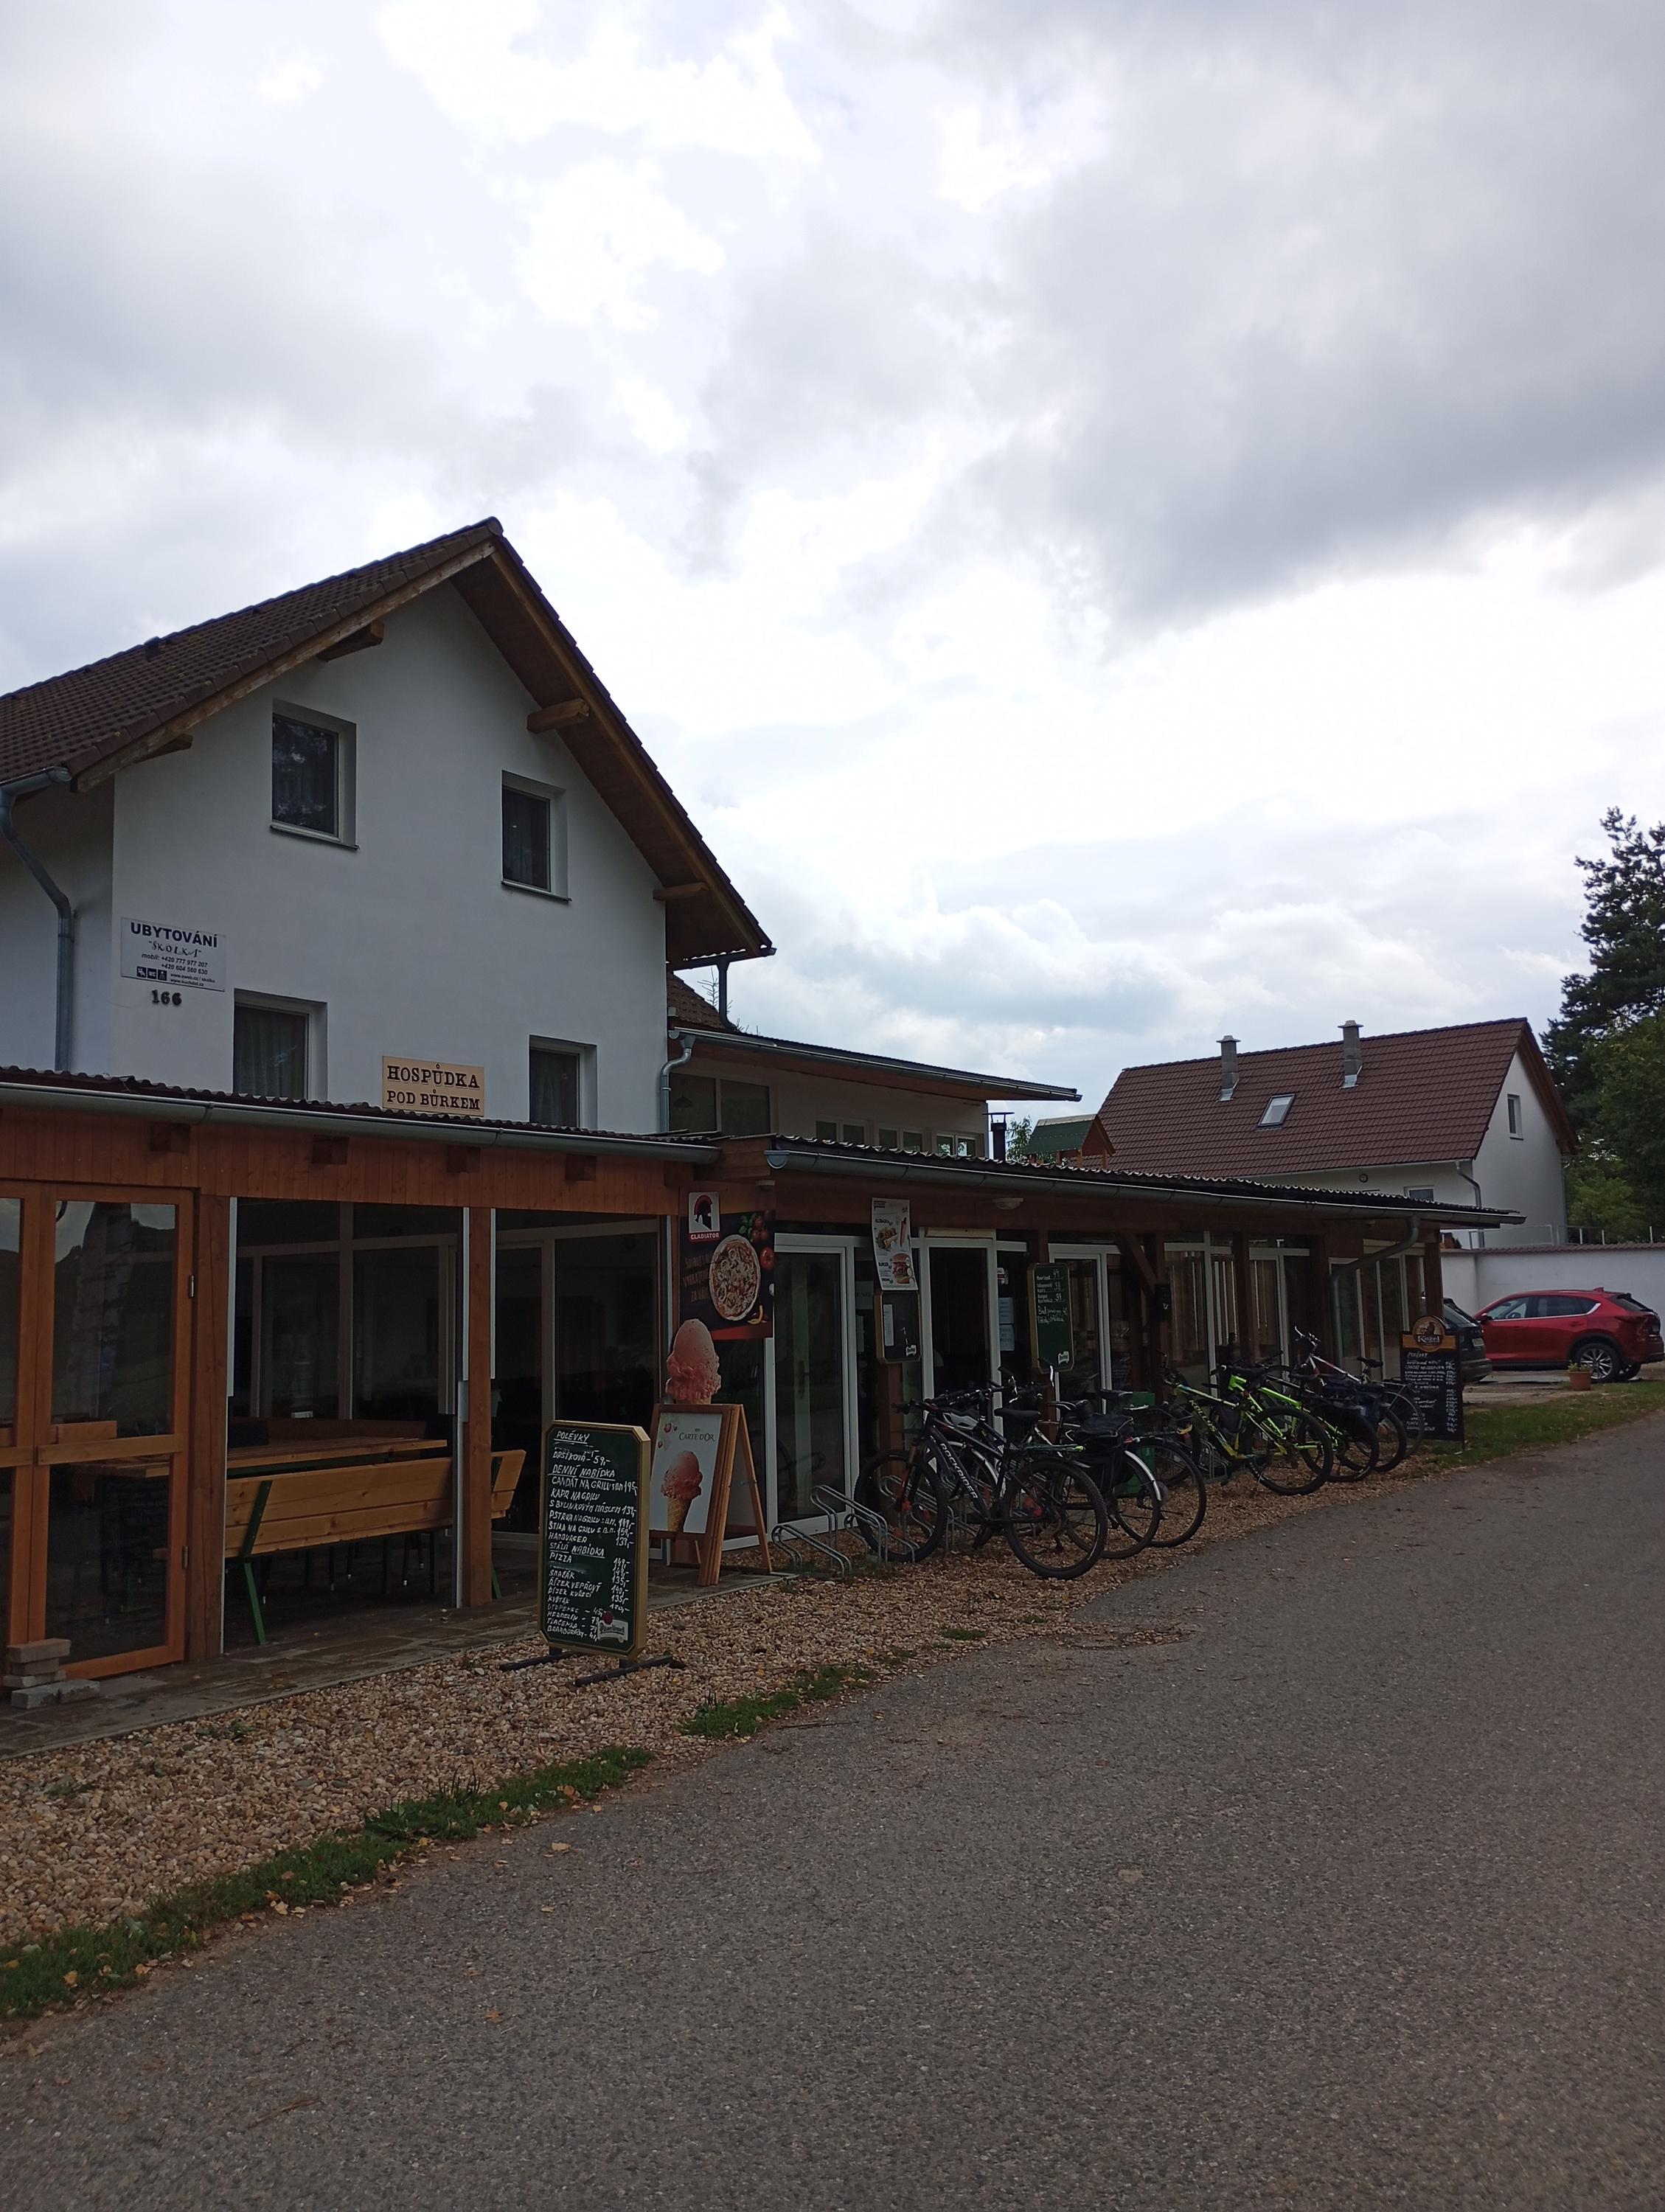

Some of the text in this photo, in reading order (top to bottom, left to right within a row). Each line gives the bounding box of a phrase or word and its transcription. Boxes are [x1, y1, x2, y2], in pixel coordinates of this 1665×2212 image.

[131, 922, 218, 947] UBYTOVÁNÍ
[152, 990, 182, 1006] 166
[387, 1063, 480, 1088] HOSPŮDKA
[387, 1089, 480, 1110] POD BŮRKEM
[690, 1232, 720, 1240] GLADIATOR
[1417, 1335, 1440, 1344] Kozel
[555, 1430, 590, 1443] POLÉVKY
[679, 1432, 715, 1442] CARTE D'OR
[552, 1464, 616, 1478] DENNÍ NABÍDKA
[939, 1443, 979, 1499] ROCKRIDER
[552, 1476, 579, 1488] CANDÁT
[580, 1478, 590, 1489] NA
[591, 1481, 612, 1491] GRILU
[551, 1488, 600, 1501] KAPR NA GRILU
[549, 1499, 555, 1507] S
[594, 1502, 621, 1514] MÁSLEM
[582, 1515, 601, 1523] GRILU
[567, 1524, 577, 1532] NA
[578, 1526, 596, 1534] GRILU
[548, 1532, 588, 1543] HAMBURGER
[571, 1543, 605, 1557] NABÍDKA
[549, 1552, 572, 1563] PIZZA
